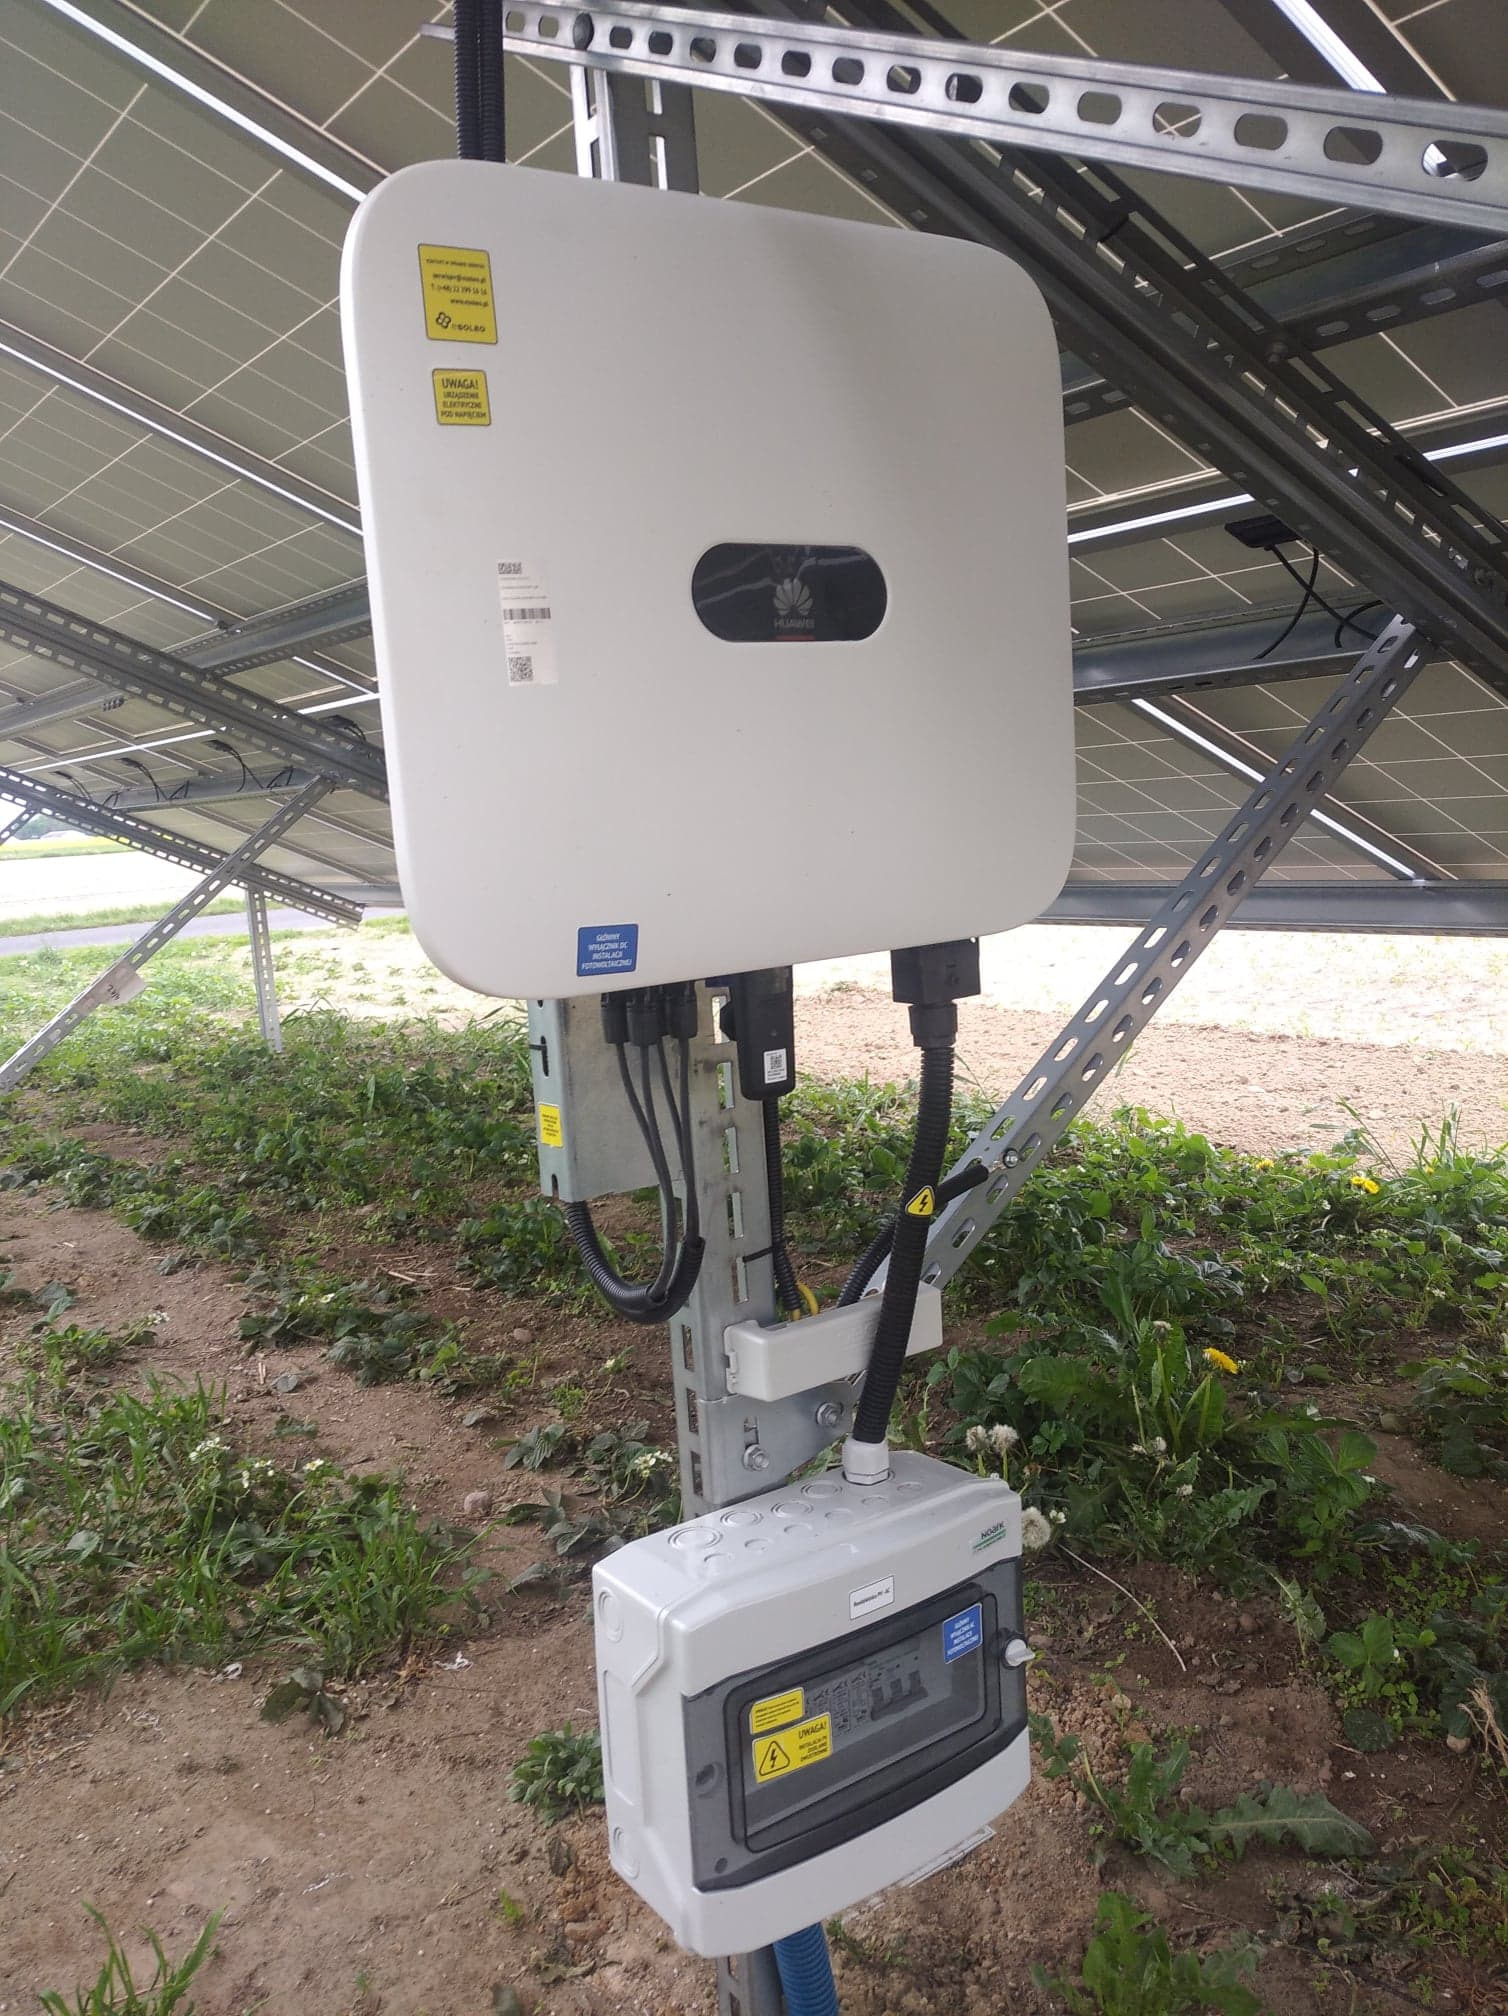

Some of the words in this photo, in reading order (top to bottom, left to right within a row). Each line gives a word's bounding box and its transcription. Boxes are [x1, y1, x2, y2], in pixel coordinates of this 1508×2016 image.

[441, 377, 480, 390] UWAGA!
[773, 616, 815, 630] HUAWEI
[798, 1720, 827, 1739] UWAGA!
